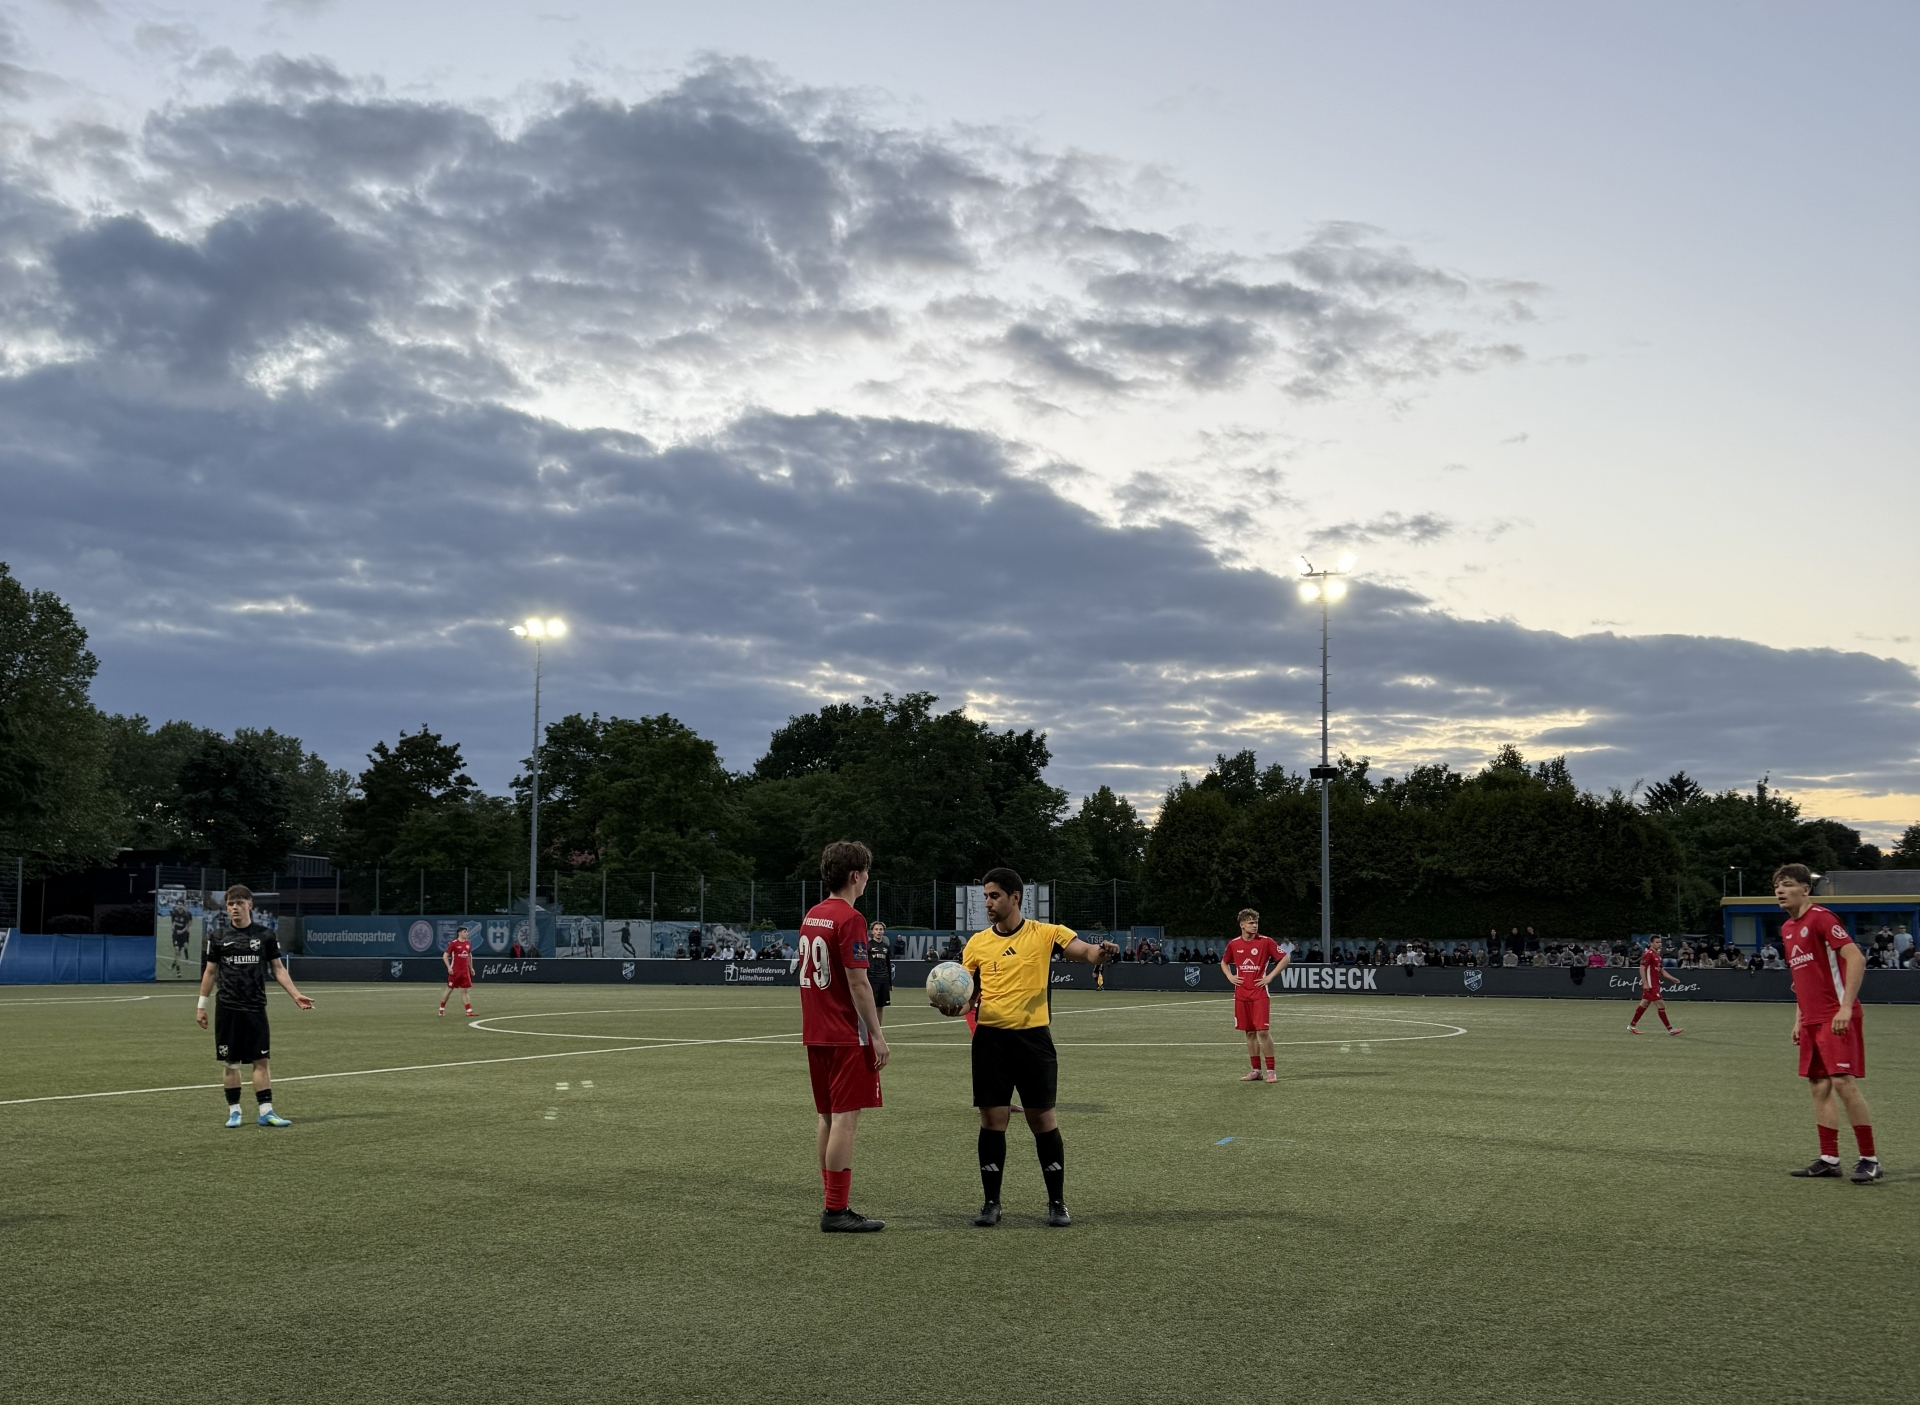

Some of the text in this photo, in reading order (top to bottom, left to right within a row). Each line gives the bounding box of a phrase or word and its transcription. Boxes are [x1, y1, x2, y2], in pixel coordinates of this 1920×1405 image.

[306, 930, 396, 944] Kooperationspartner
[764, 935, 776, 943] TSG
[502, 963, 519, 974] dich
[520, 961, 538, 976] frei
[799, 935, 831, 990] 29
[739, 965, 786, 976] Talentförderung
[739, 974, 774, 982] Mittelhessen
[1281, 967, 1378, 990] WIESECK
[1660, 983, 1701, 993] nders.
